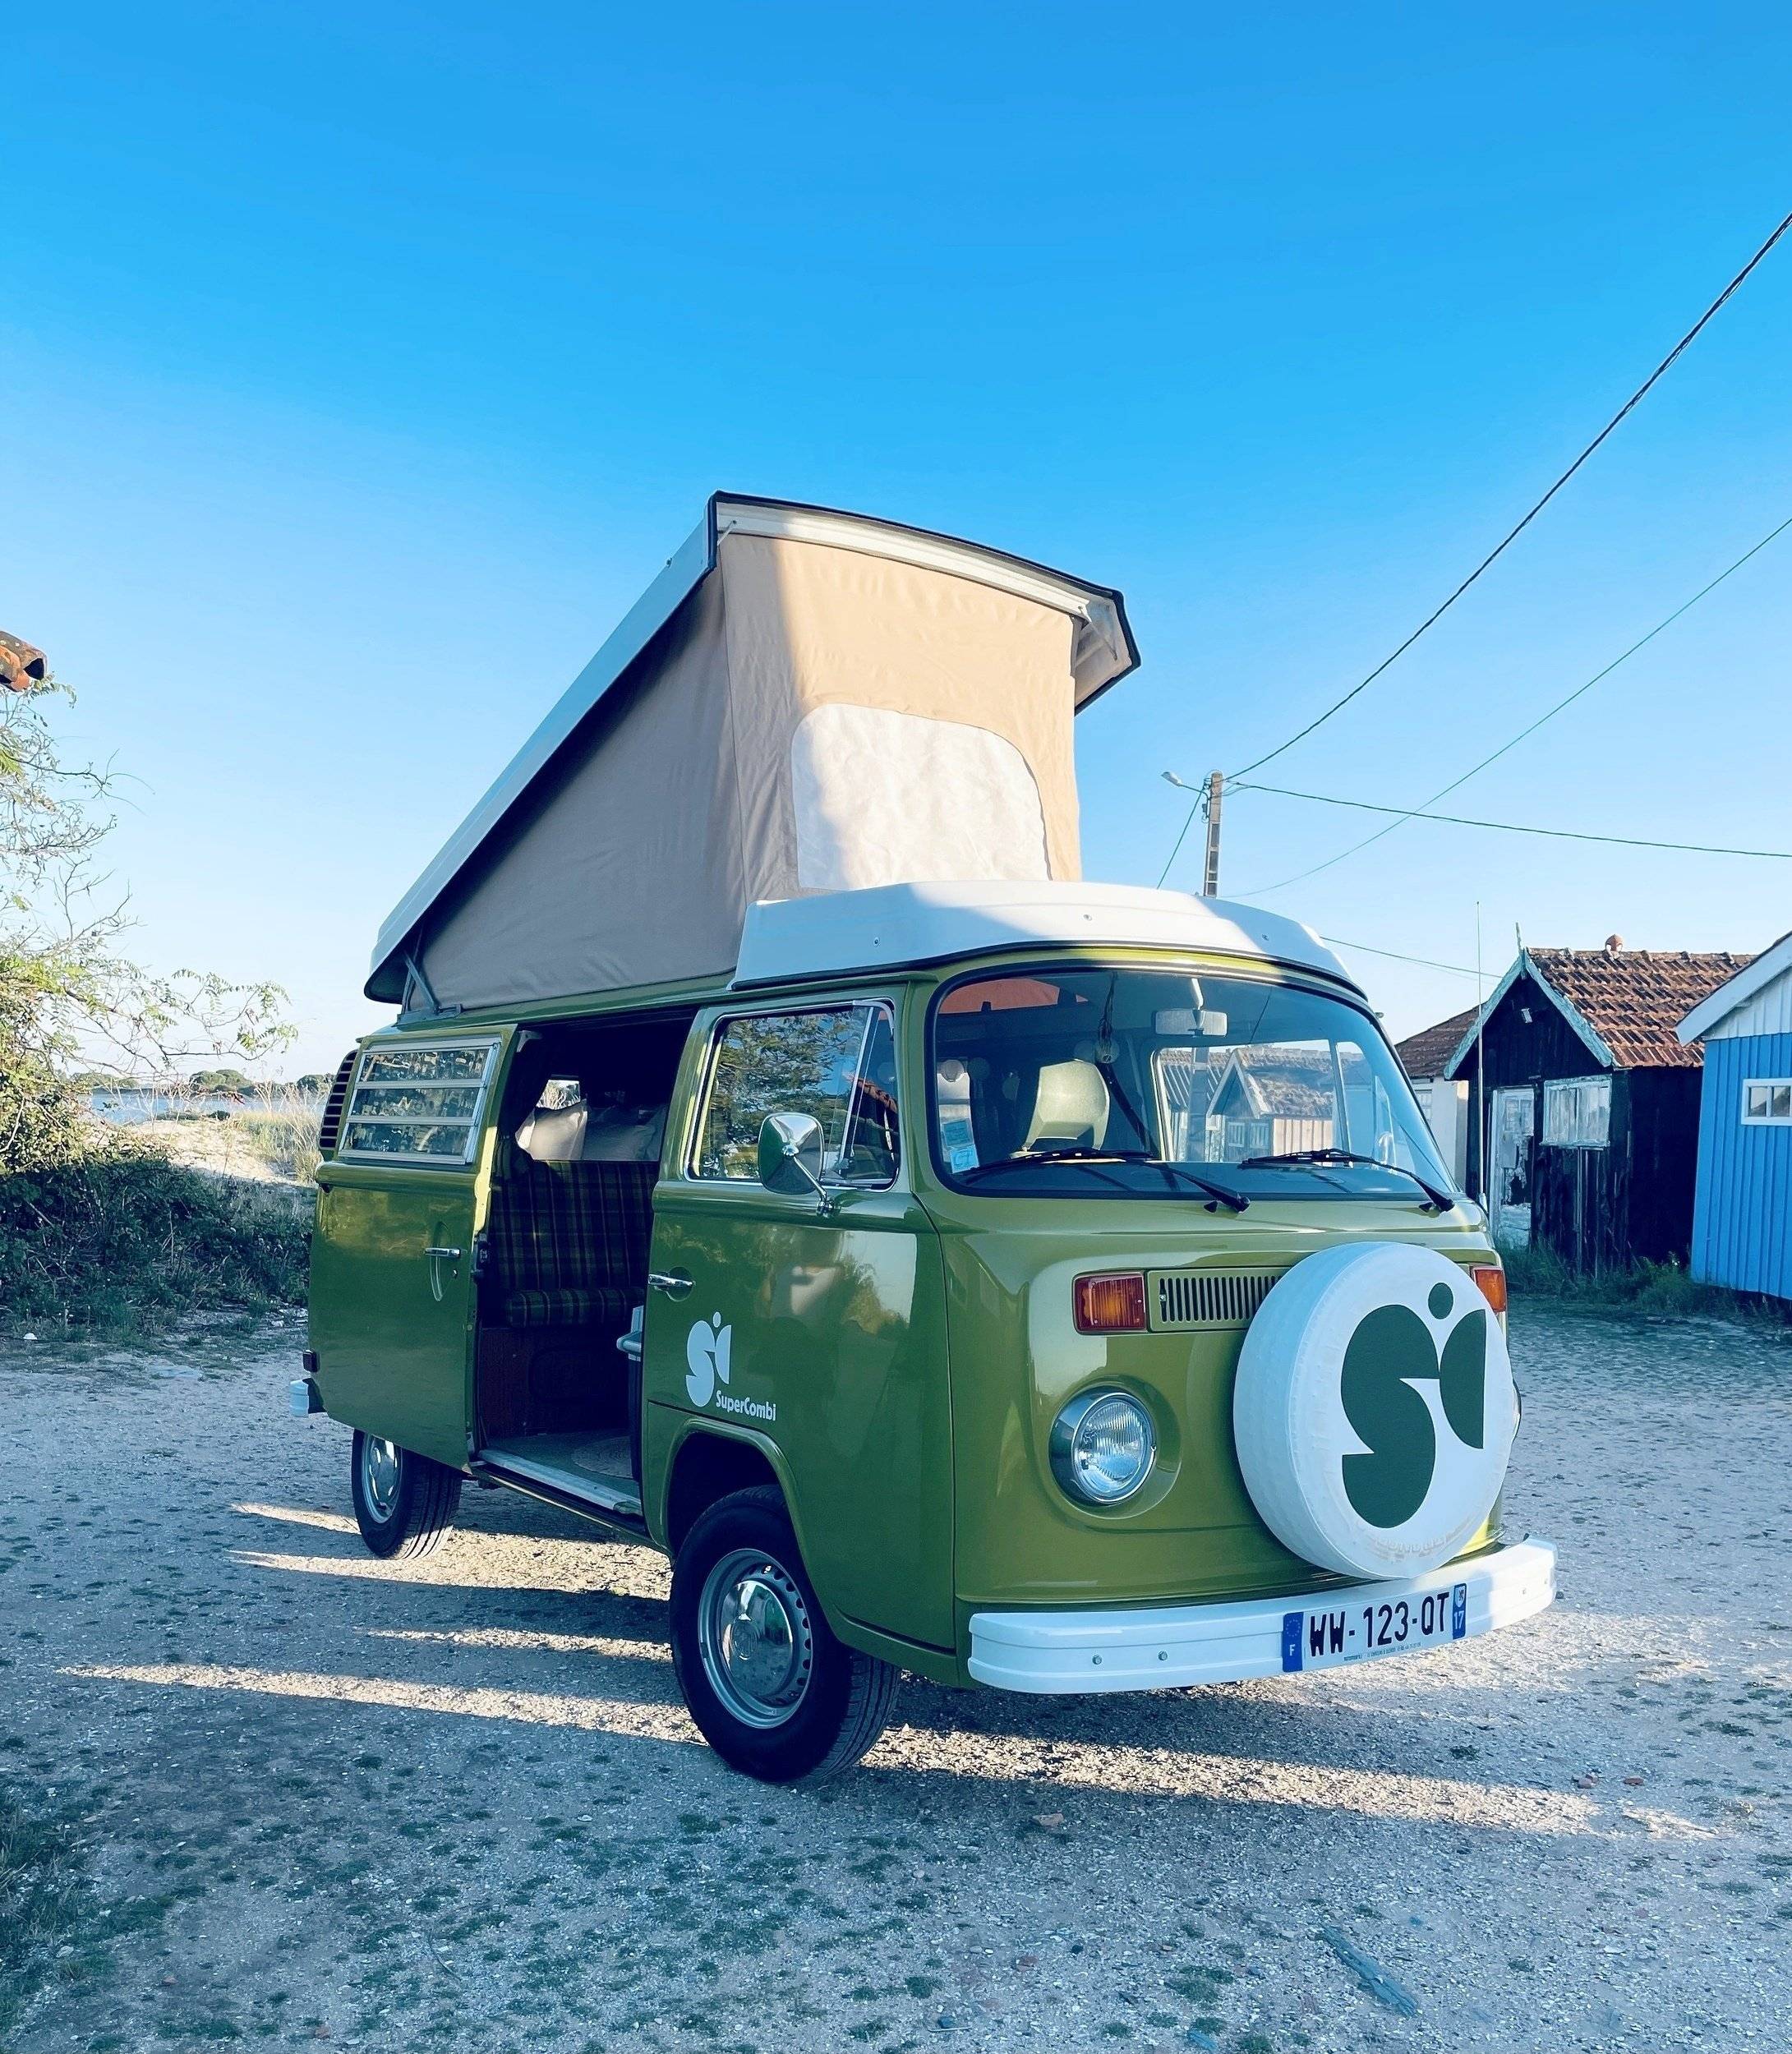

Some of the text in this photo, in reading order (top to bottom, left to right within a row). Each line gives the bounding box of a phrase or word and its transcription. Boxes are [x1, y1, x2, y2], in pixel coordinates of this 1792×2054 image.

[716, 1390, 776, 1421] SuperCombi
[1453, 1610, 1464, 1630] 17
[1288, 1643, 1296, 1656] F
